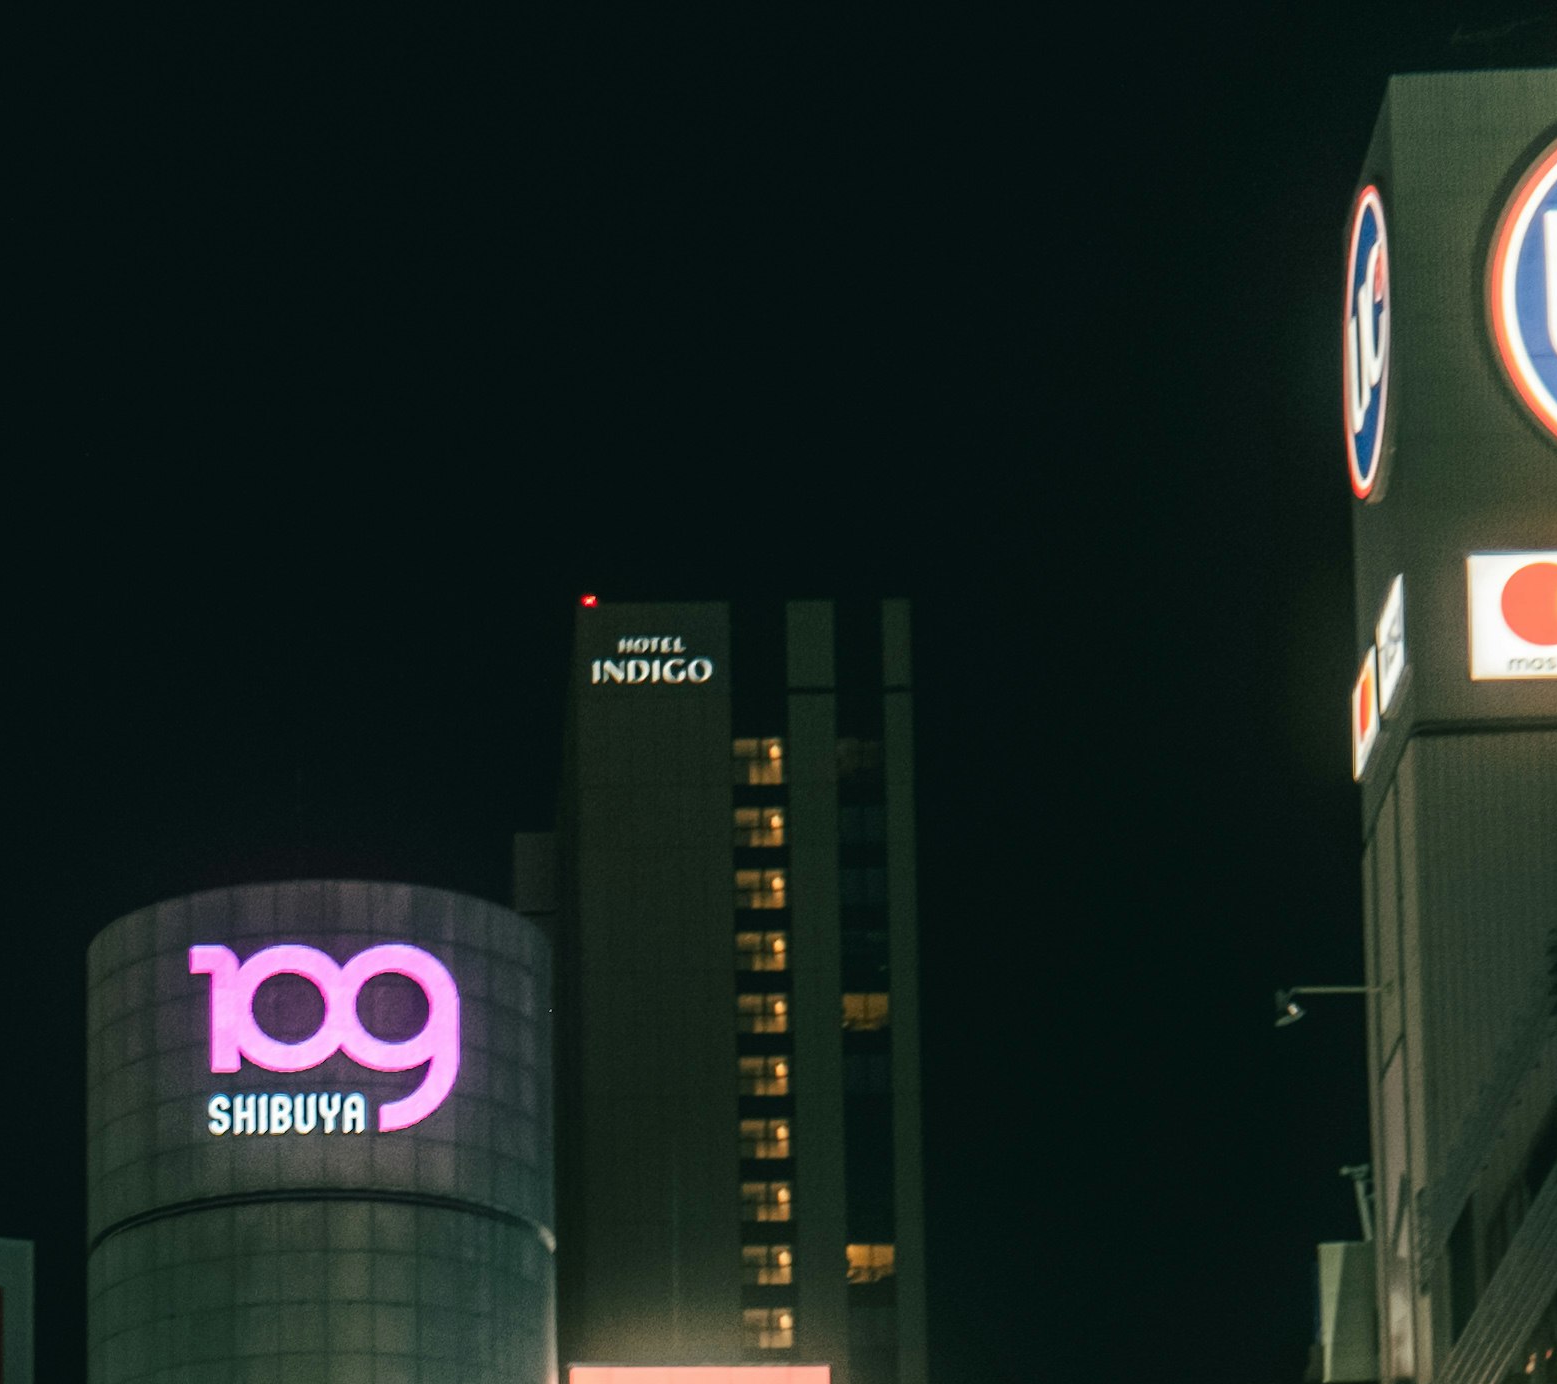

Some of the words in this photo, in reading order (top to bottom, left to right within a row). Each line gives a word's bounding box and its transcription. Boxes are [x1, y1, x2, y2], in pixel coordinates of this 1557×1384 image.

[618, 637, 687, 655] HOTEL
[592, 658, 714, 685] INDIGO
[189, 945, 460, 1133] 109
[208, 1093, 366, 1137] SHIBUYA
